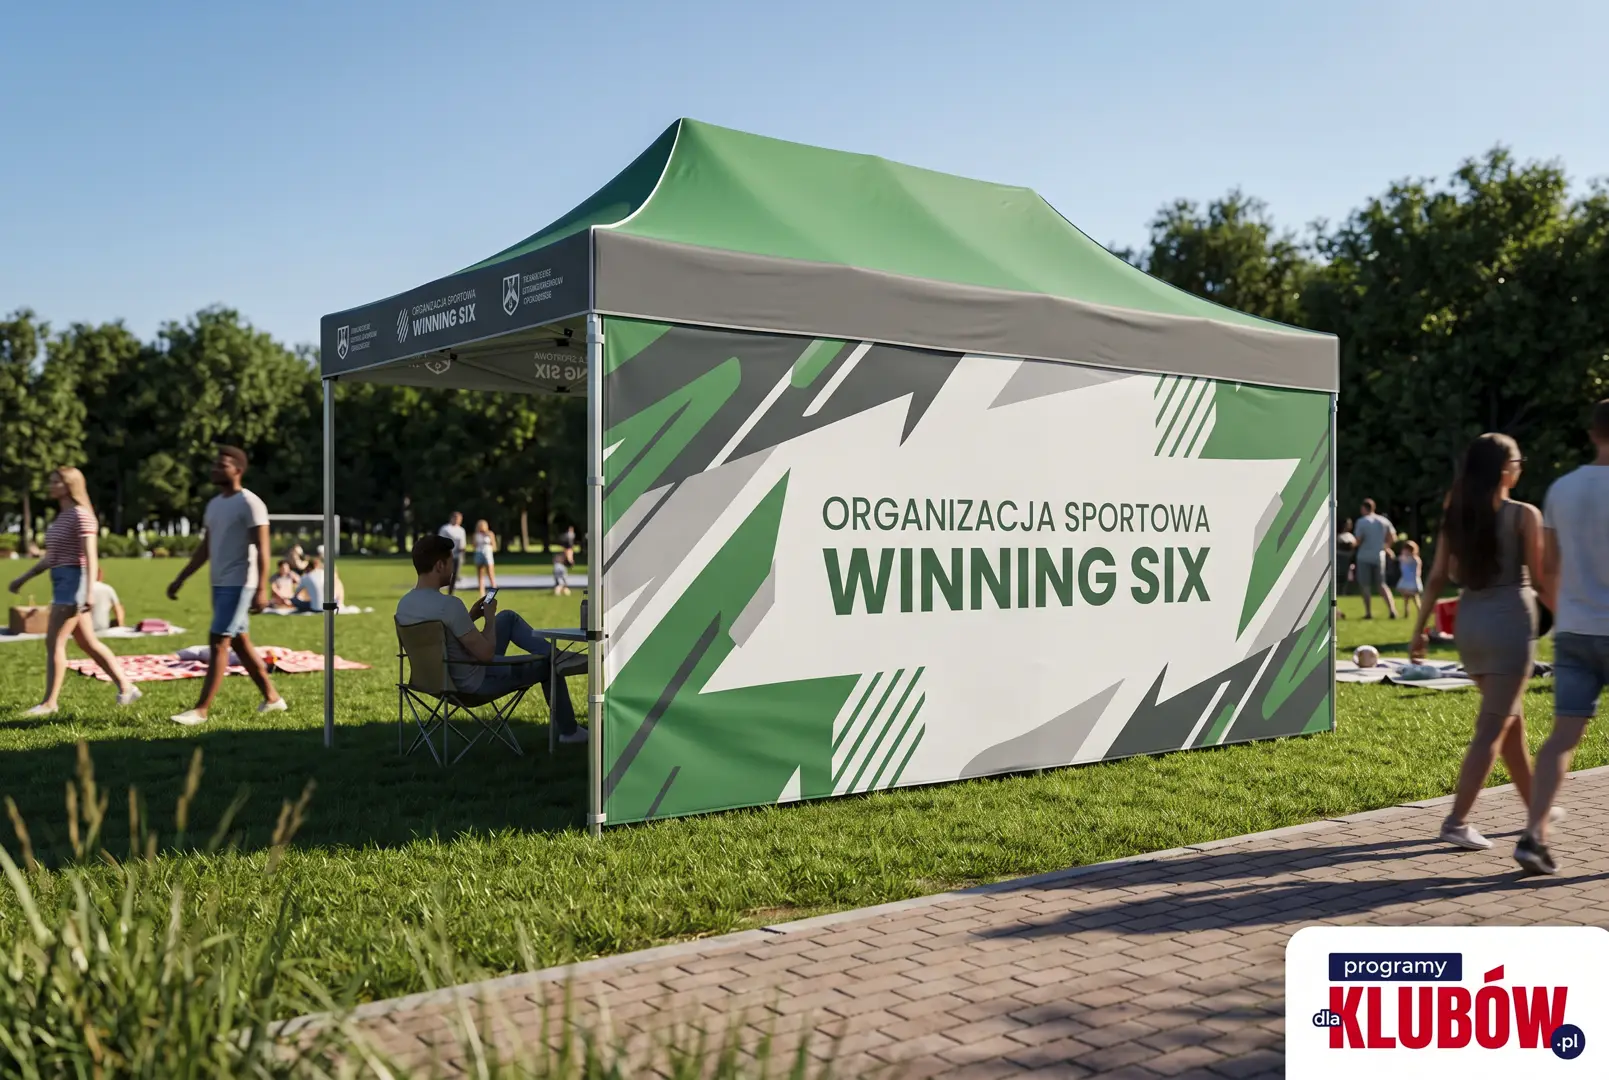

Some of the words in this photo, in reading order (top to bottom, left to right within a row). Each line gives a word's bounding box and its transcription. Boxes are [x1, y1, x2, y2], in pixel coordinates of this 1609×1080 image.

[411, 298, 447, 316] ORGANIZACJA
[447, 289, 477, 306] SPORTOWA
[412, 309, 457, 337] WINNING
[458, 303, 476, 325] SIX
[822, 496, 1056, 532] ORGANIZACJA
[1065, 501, 1211, 533] SPORTOWA
[822, 547, 1117, 616] WINNING
[1130, 546, 1211, 605] SIX
